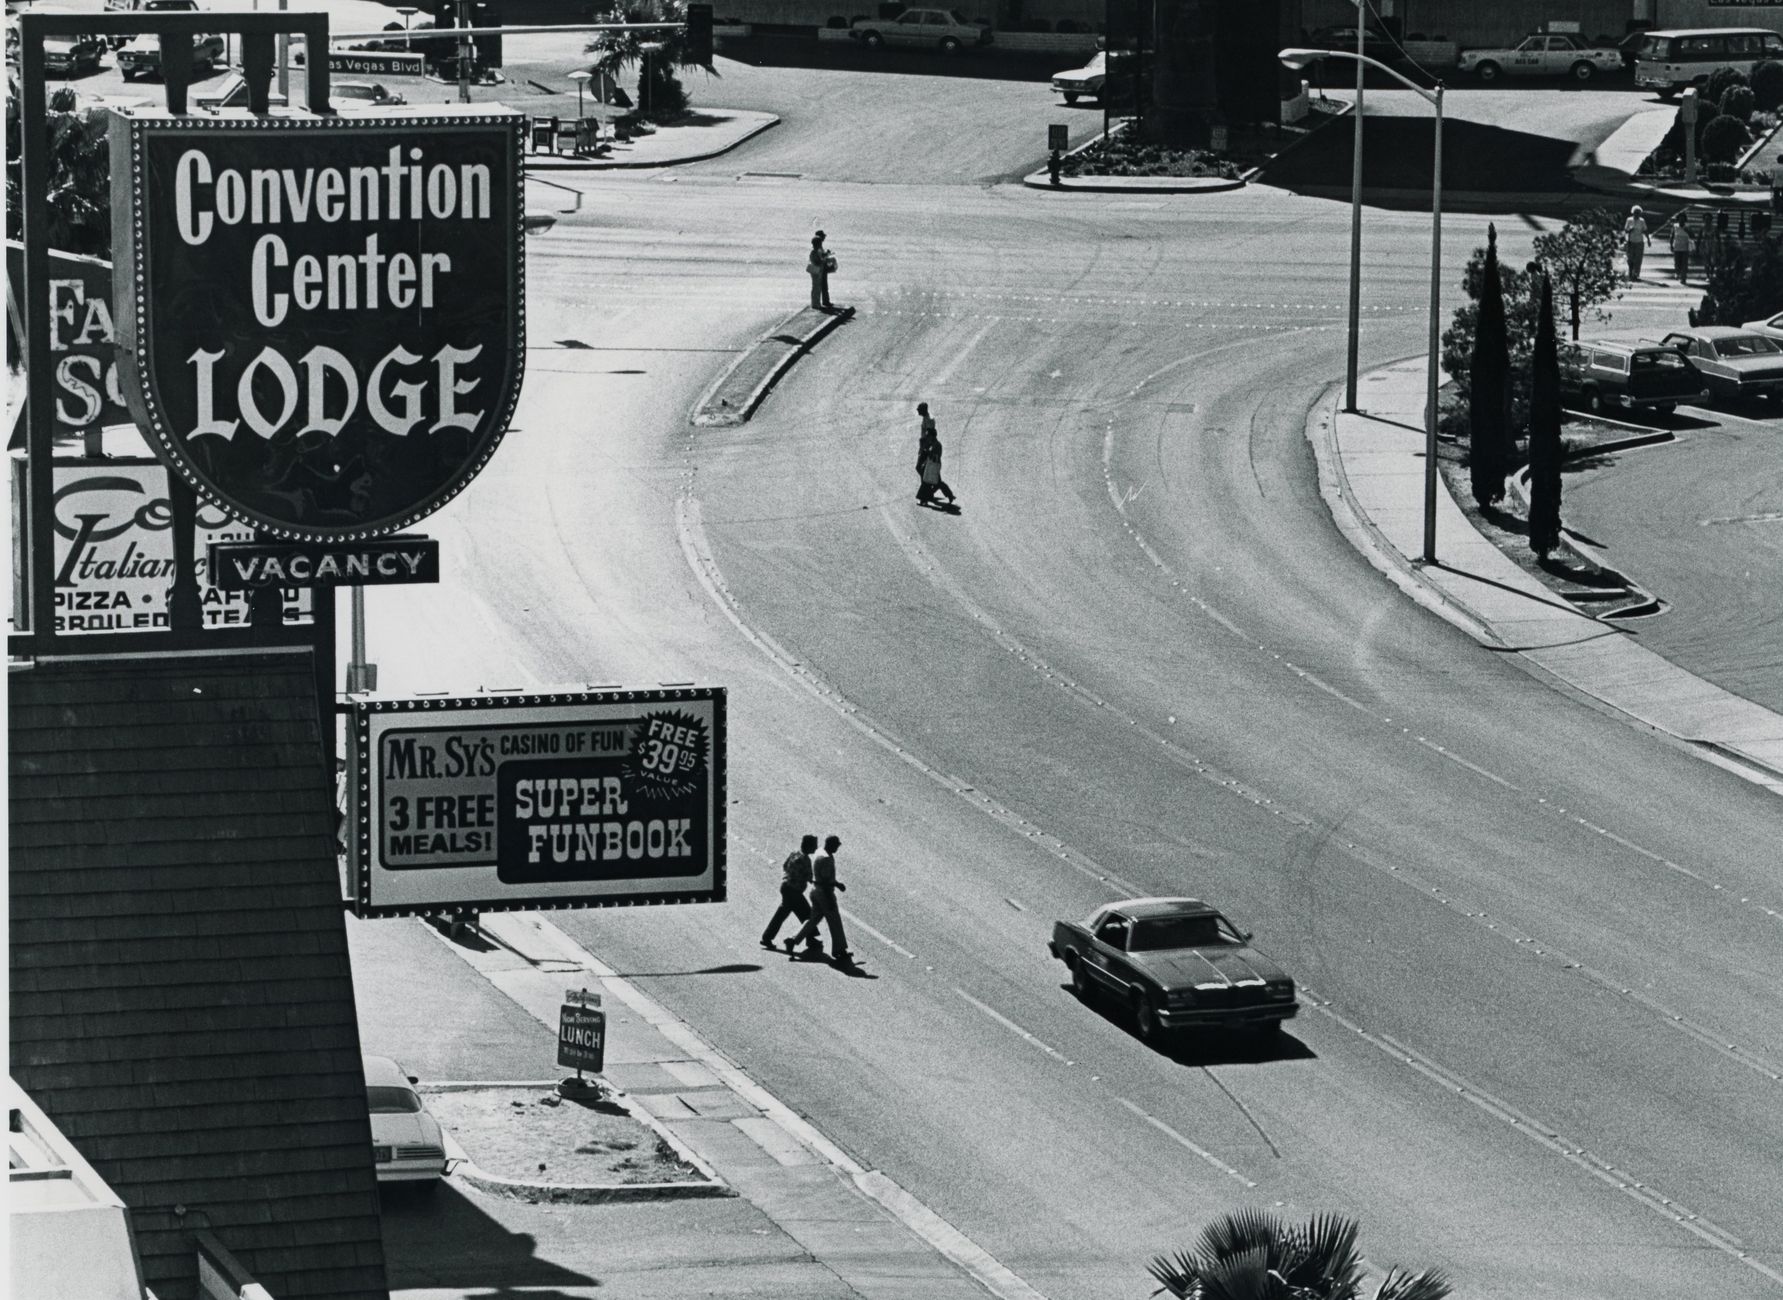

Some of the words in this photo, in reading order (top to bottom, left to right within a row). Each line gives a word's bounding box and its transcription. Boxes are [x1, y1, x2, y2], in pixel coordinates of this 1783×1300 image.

[345, 59, 385, 74] Vegas
[391, 60, 420, 72] Blvd
[176, 144, 490, 246] Convention
[251, 232, 451, 328] Center
[186, 343, 485, 441] LODGE
[232, 552, 426, 581] VACANCY
[55, 591, 132, 610] PIZZA
[55, 612, 168, 631] BROILED
[500, 733, 560, 756] CASINO
[565, 731, 586, 754] OF
[591, 730, 625, 751] FUN
[648, 719, 699, 748] FREE
[640, 770, 679, 786] VALUE
[516, 776, 628, 819] SUPER
[389, 796, 410, 831] 3
[416, 794, 495, 830] FREE
[390, 831, 492, 857] MEALS!
[528, 818, 692, 863] FUNBOOK
[560, 1025, 601, 1049] LUNCH
